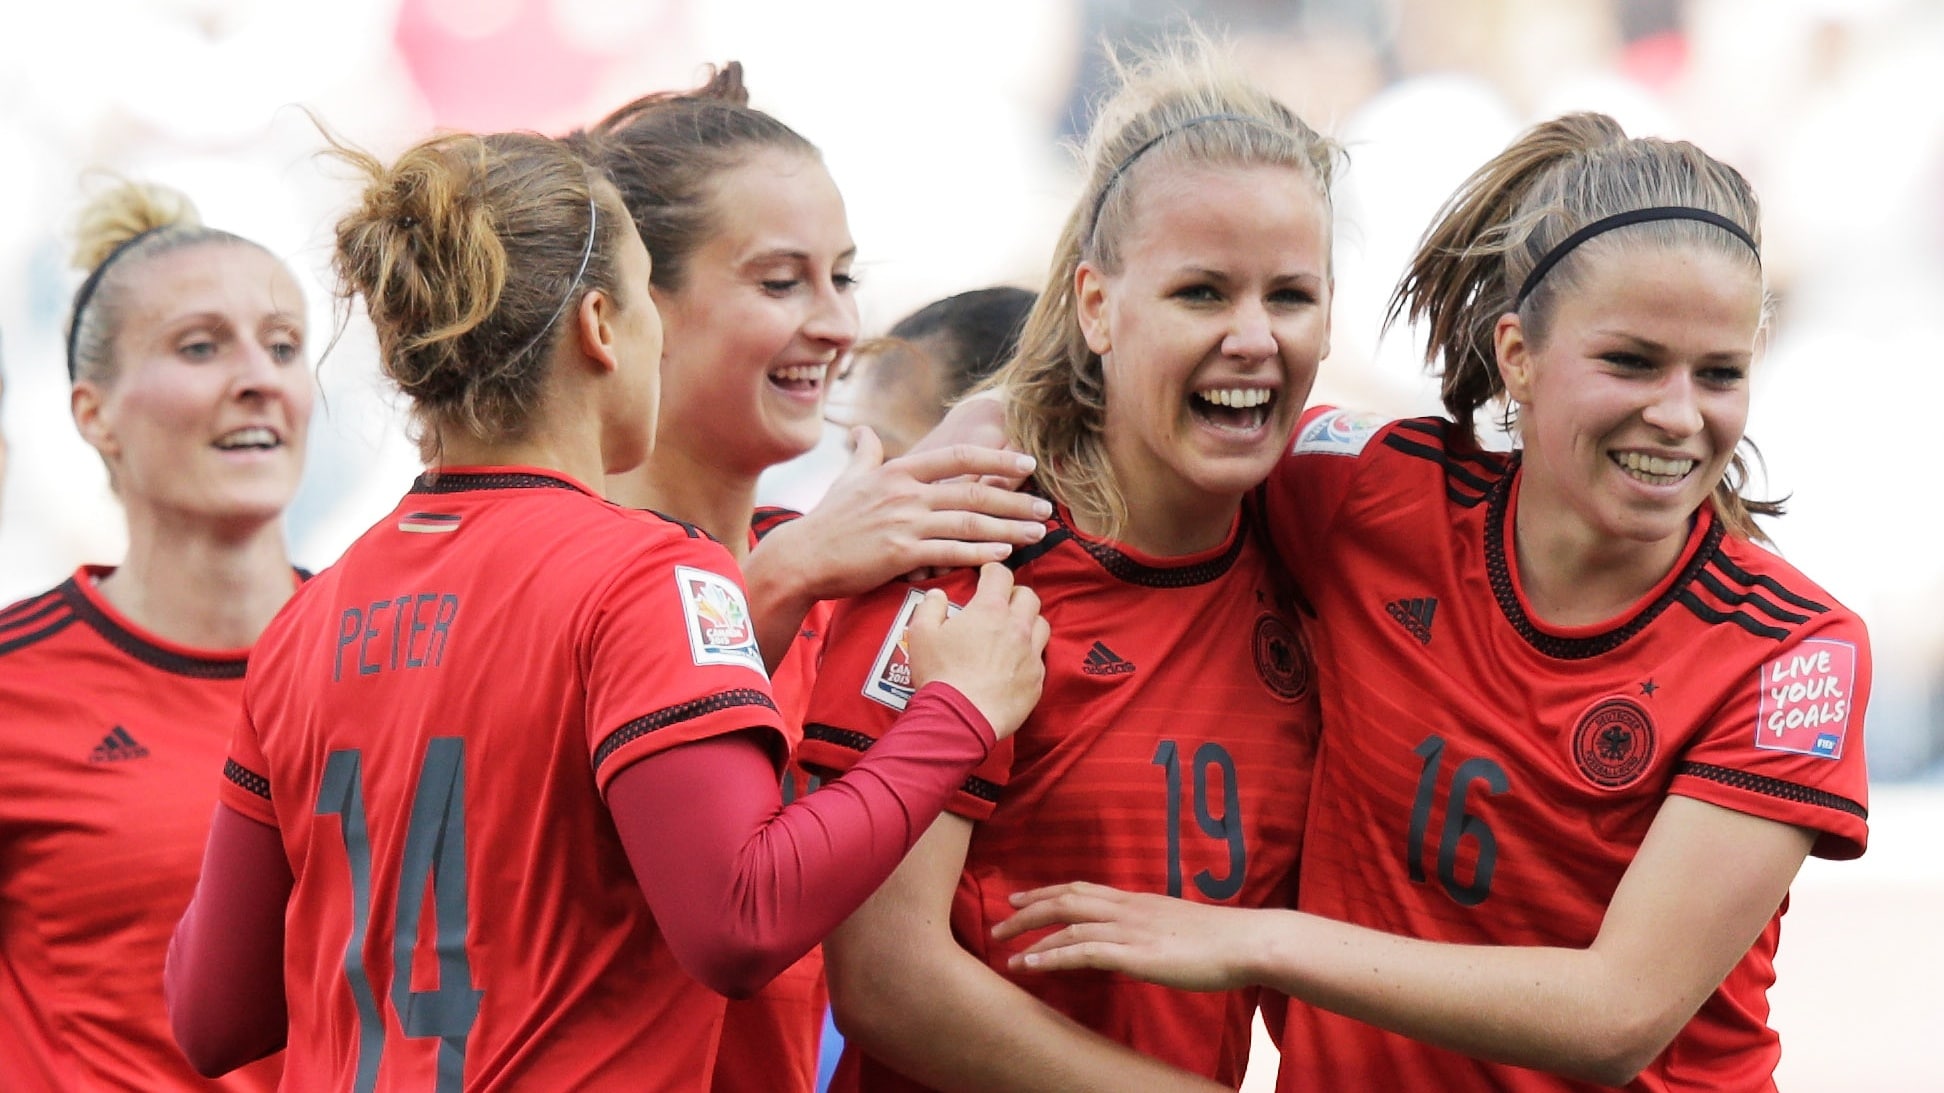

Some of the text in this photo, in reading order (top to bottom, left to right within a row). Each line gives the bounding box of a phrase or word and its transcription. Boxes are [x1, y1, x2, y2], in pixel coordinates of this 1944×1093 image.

[333, 593, 458, 682] PETER
[888, 672, 910, 685] 2015
[890, 663, 910, 676] CAN
[1082, 662, 1137, 676] adidas
[1772, 651, 1831, 682] LIVE
[1771, 676, 1843, 709] YOUR
[1768, 700, 1846, 738] GOALS
[1152, 740, 1246, 900] 19
[1407, 735, 1510, 906] 16
[314, 736, 485, 1093] 14
